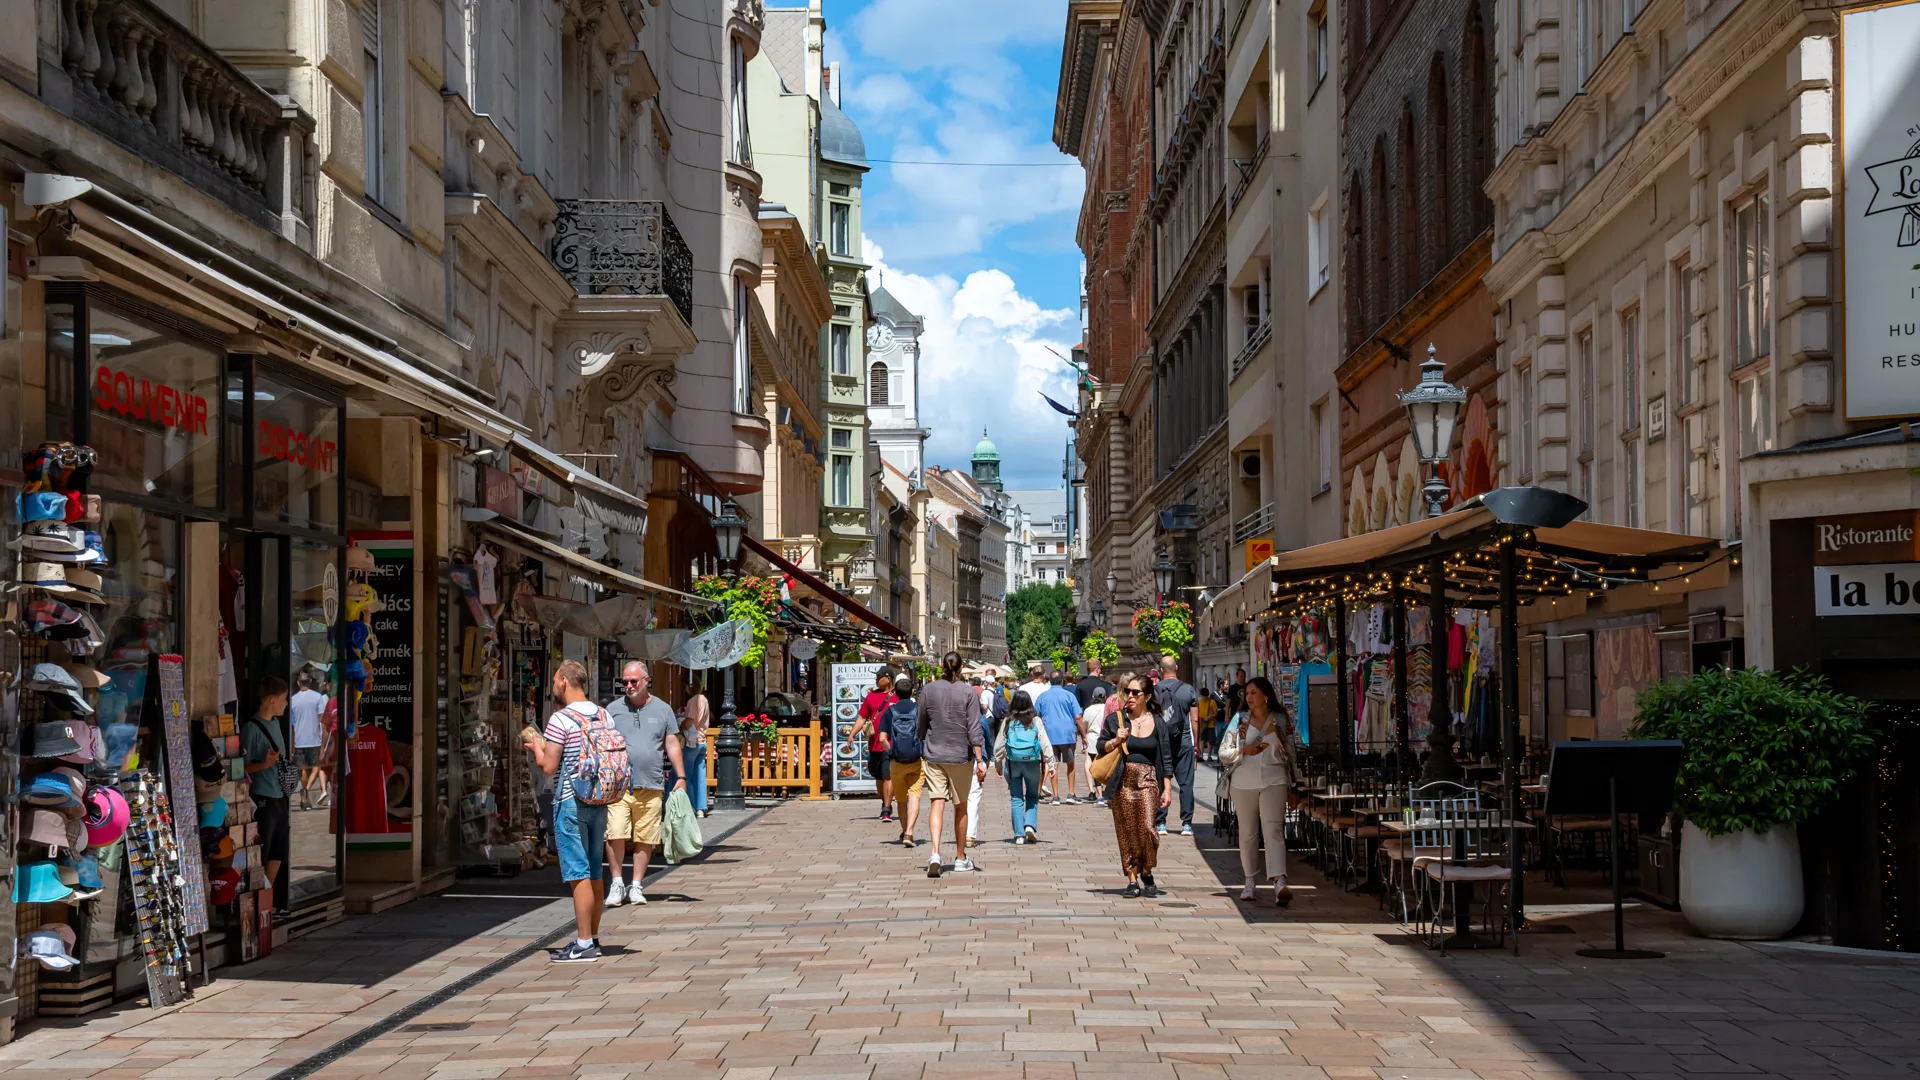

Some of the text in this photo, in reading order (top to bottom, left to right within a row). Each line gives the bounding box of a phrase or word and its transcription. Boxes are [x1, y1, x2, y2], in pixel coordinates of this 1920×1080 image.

[1911, 286, 1920, 299] I
[97, 366, 208, 436] SOUVENIR
[259, 420, 336, 473] DISCOUNT
[1817, 524, 1913, 552] Ristorante
[1830, 574, 1869, 607] la
[383, 594, 411, 612] lács
[375, 618, 399, 631] cake
[378, 644, 411, 658] rmék
[372, 665, 401, 676] oduct
[371, 682, 408, 692] ózmentes
[371, 695, 397, 704] lactose
[397, 695, 412, 704] free
[374, 715, 393, 731] Ft
